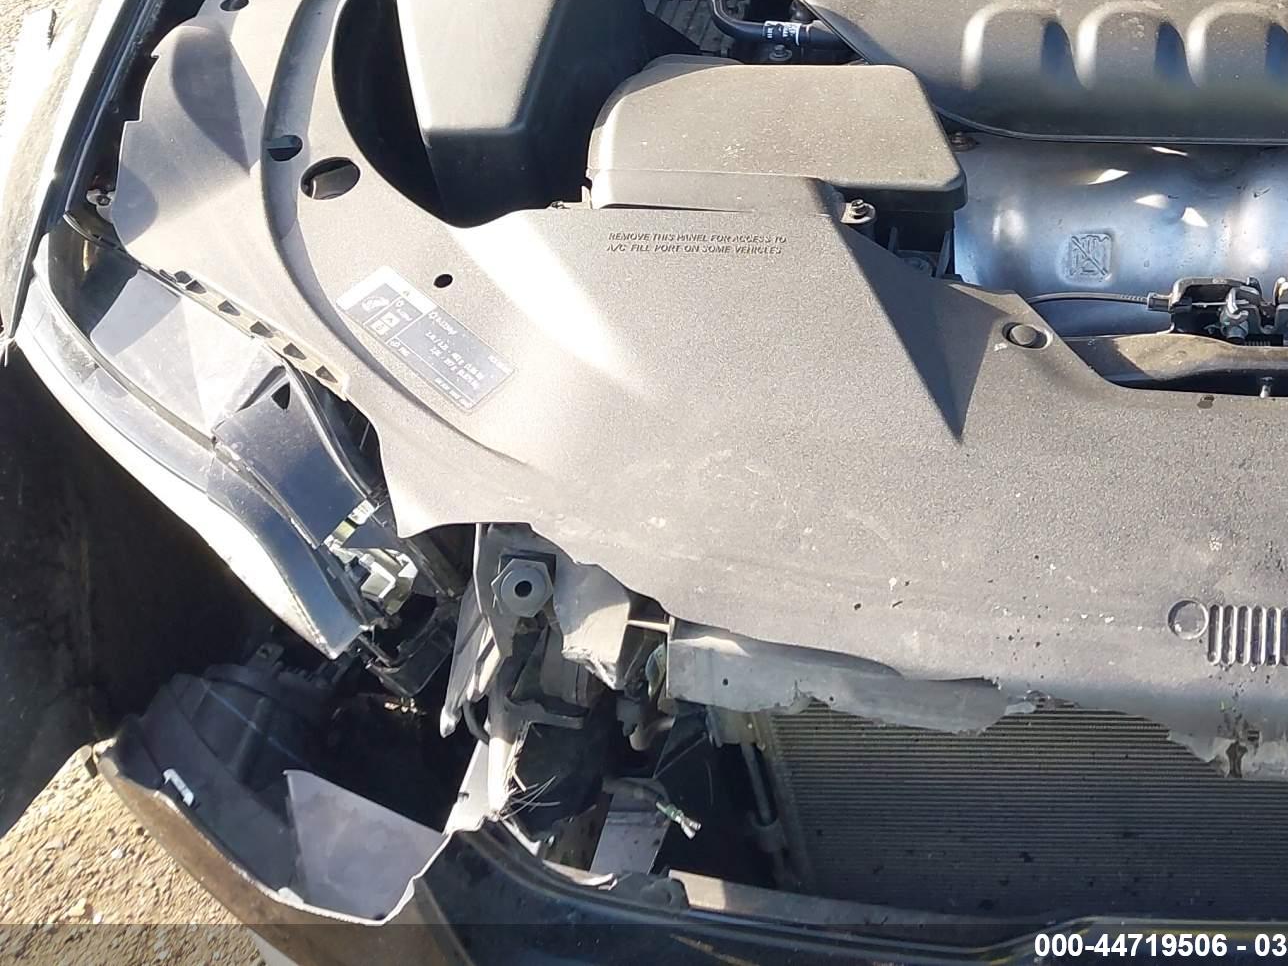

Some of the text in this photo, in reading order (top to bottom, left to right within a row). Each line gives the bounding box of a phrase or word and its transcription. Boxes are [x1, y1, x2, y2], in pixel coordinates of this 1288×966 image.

[608, 232, 787, 244] REMOVE THIS PANEL FOR ACCESS TO
[606, 243, 782, 254] A/C FILL PORT ON SOME VEHICLES
